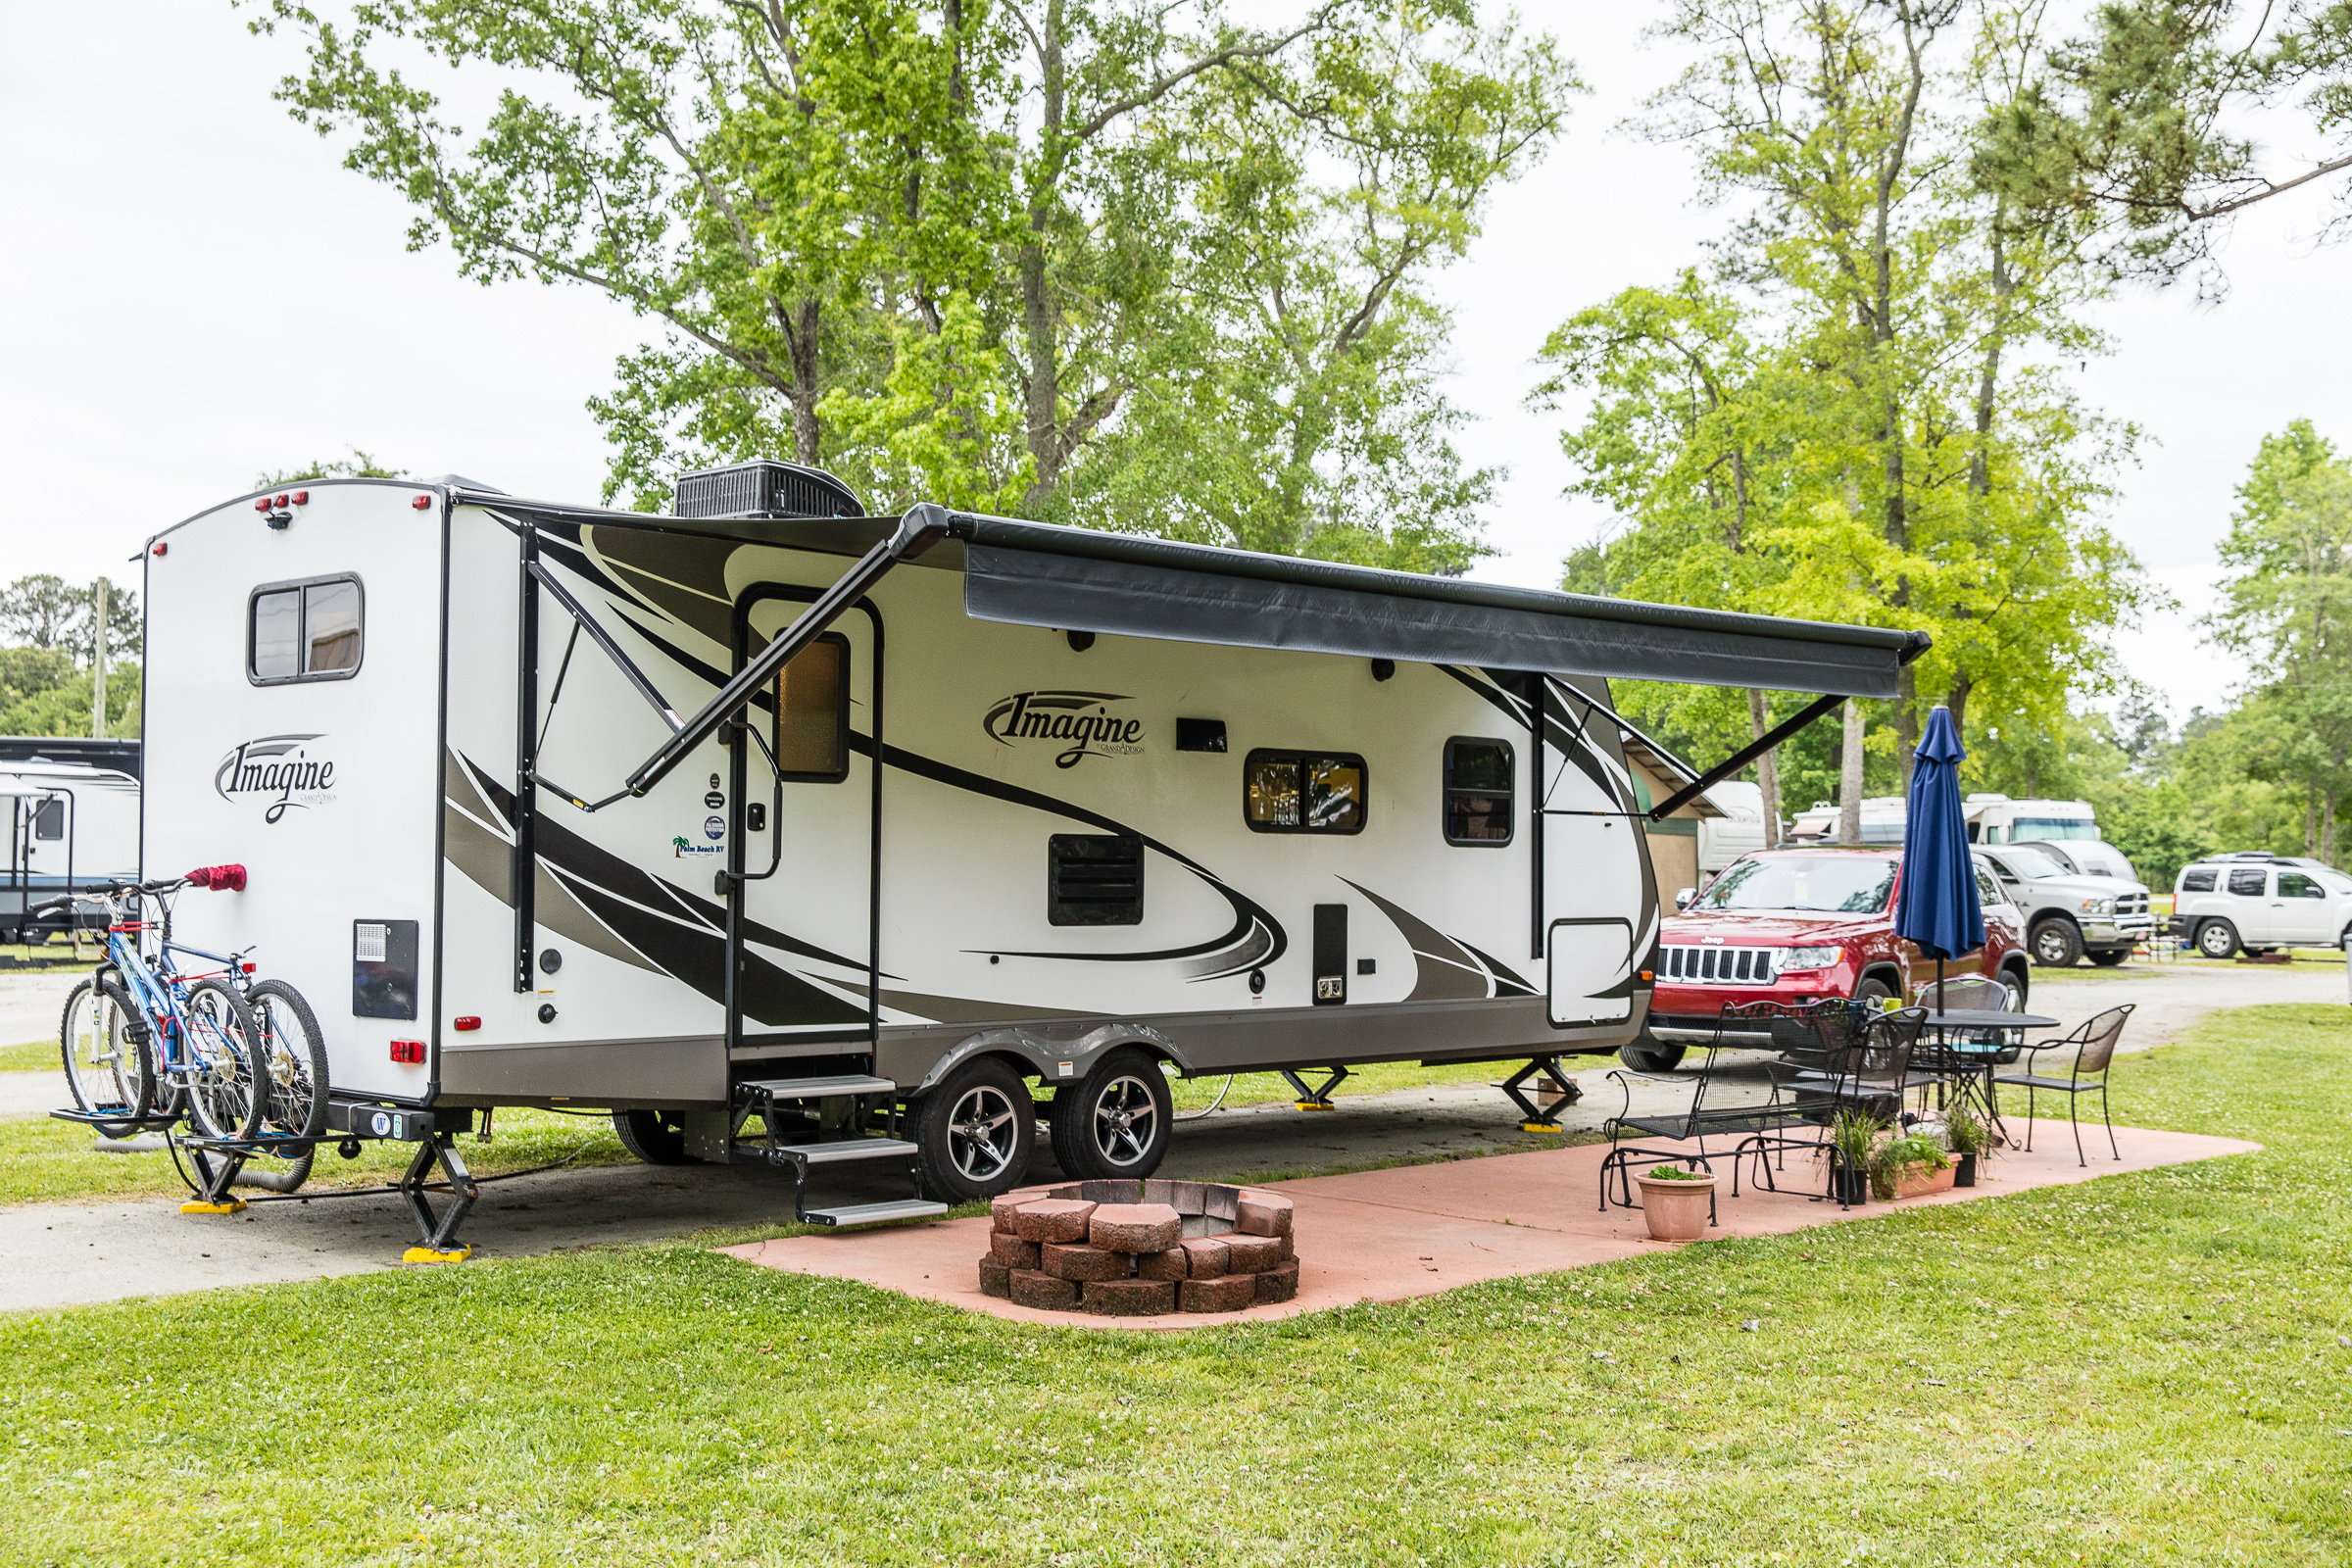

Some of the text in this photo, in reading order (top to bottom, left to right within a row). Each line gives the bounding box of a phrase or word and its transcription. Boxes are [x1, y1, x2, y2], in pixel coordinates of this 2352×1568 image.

[1000, 692, 1146, 768] Imagine
[1101, 744, 1120, 753] GRAND
[226, 742, 338, 824] Imagine
[1700, 935, 1725, 946] Jeep
[376, 1117, 386, 1131] W
